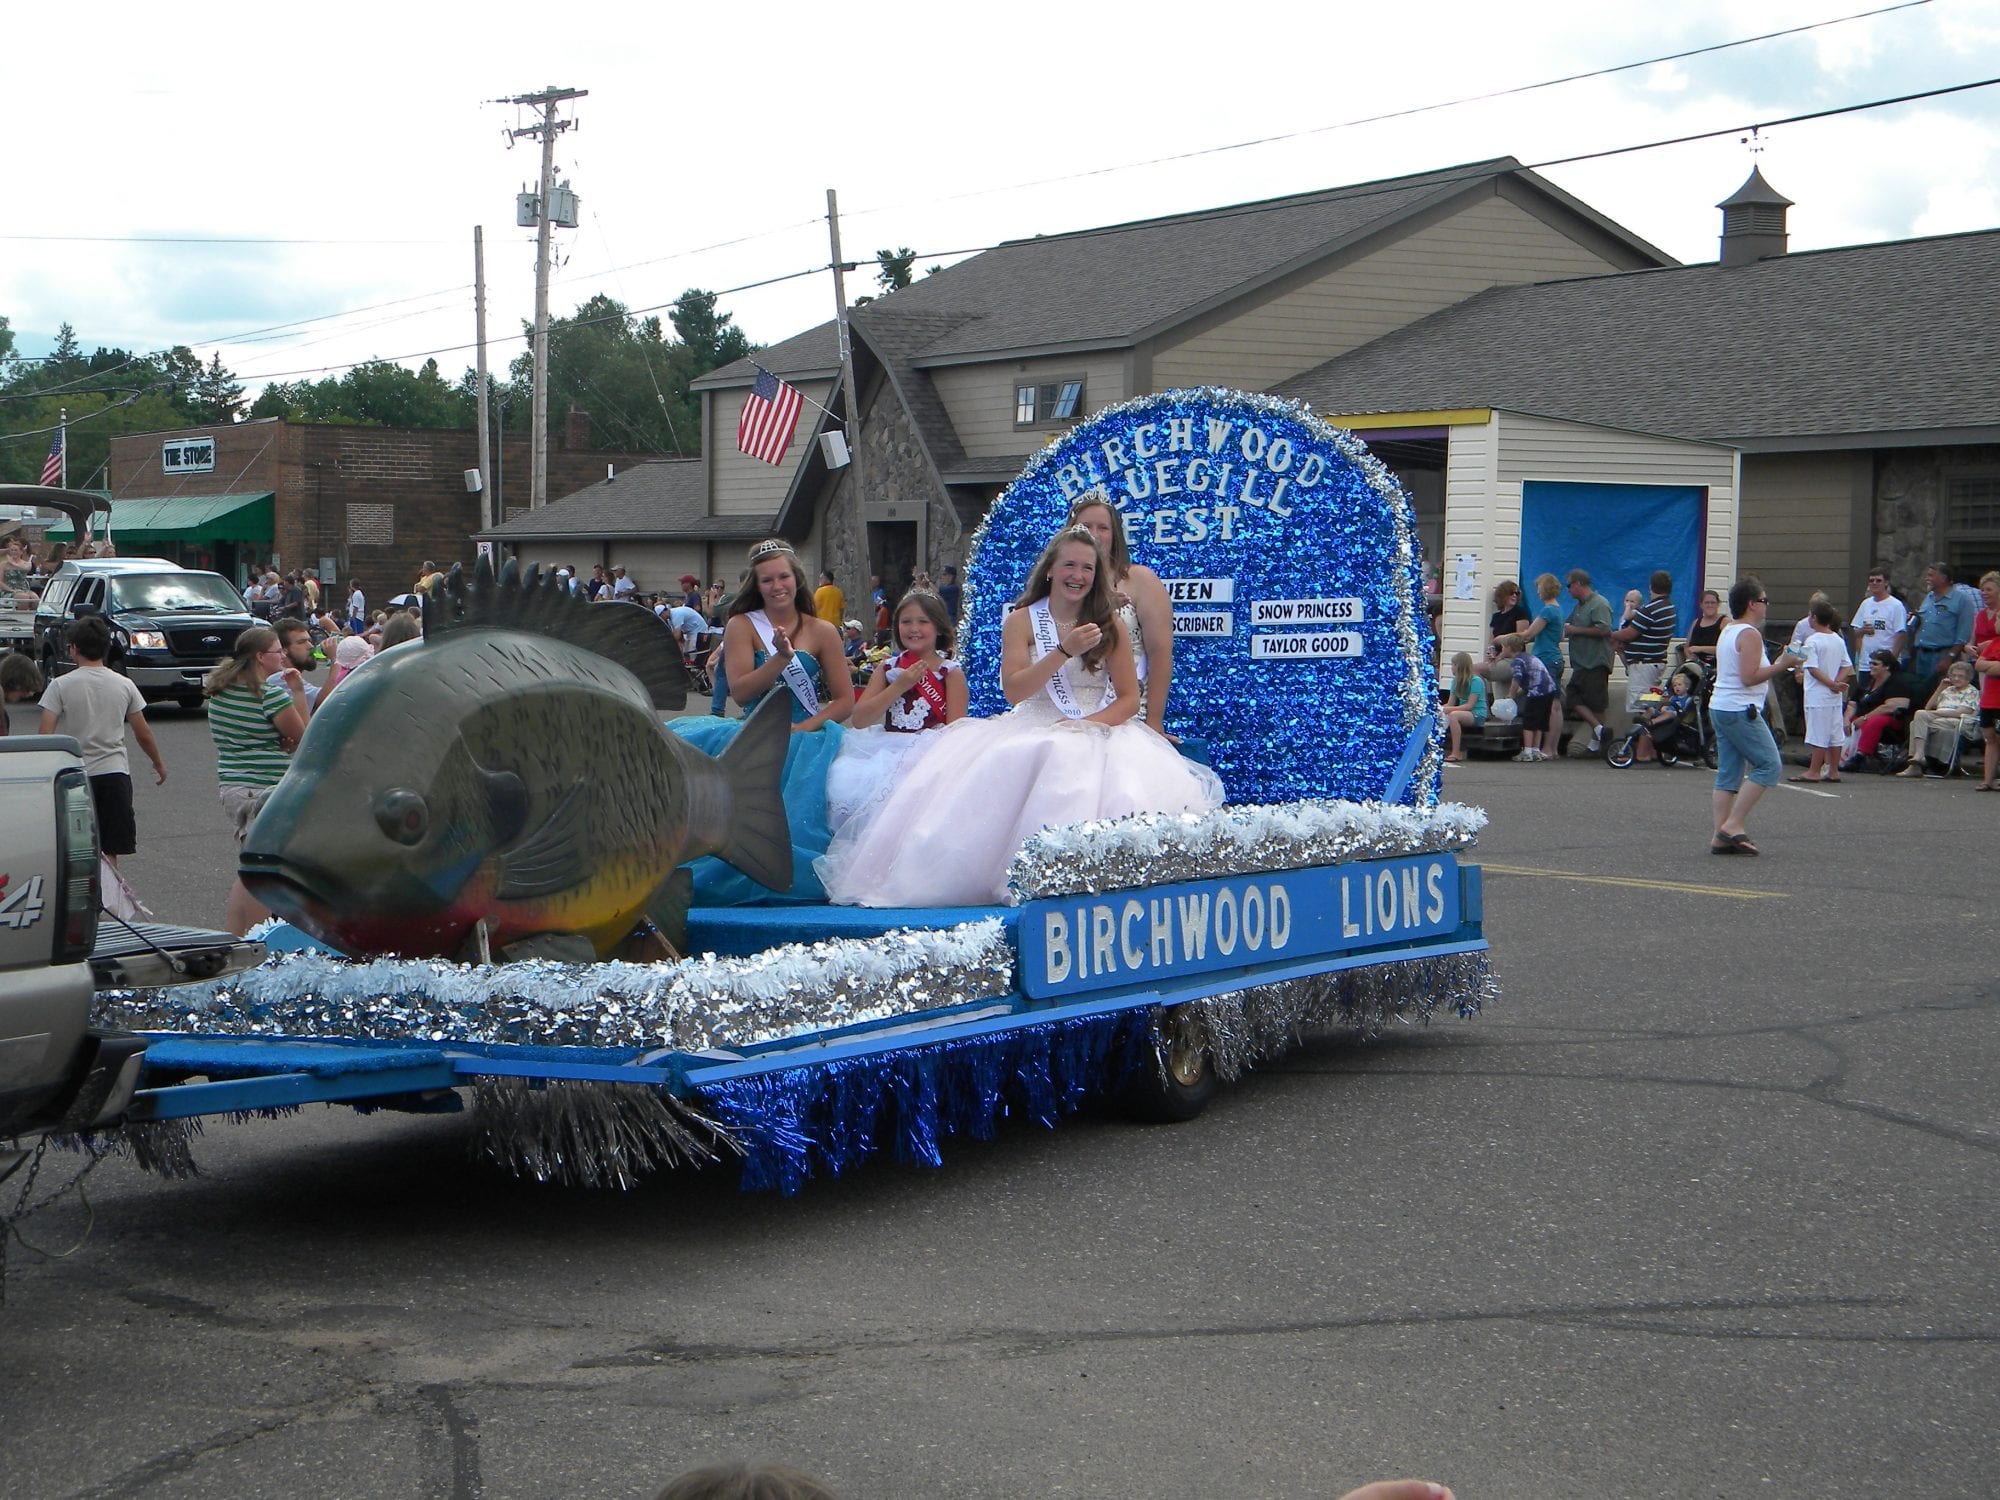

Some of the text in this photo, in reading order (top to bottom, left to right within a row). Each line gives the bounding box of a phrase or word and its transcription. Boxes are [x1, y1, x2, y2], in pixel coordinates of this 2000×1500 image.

[165, 445, 212, 467] THE STORE
[1054, 418, 1325, 501] BIRCHWOOD
[1074, 458, 1292, 517] LUEGILL
[1121, 506, 1242, 546] FEST
[1163, 582, 1214, 600] UEEN
[1258, 602, 1353, 620] SNOW PRINCESS
[1172, 616, 1224, 633] SCRIBNER
[1262, 636, 1349, 654] TAYLOR GOOD
[1045, 862, 1444, 984] BIRCHWOOD LIONS
